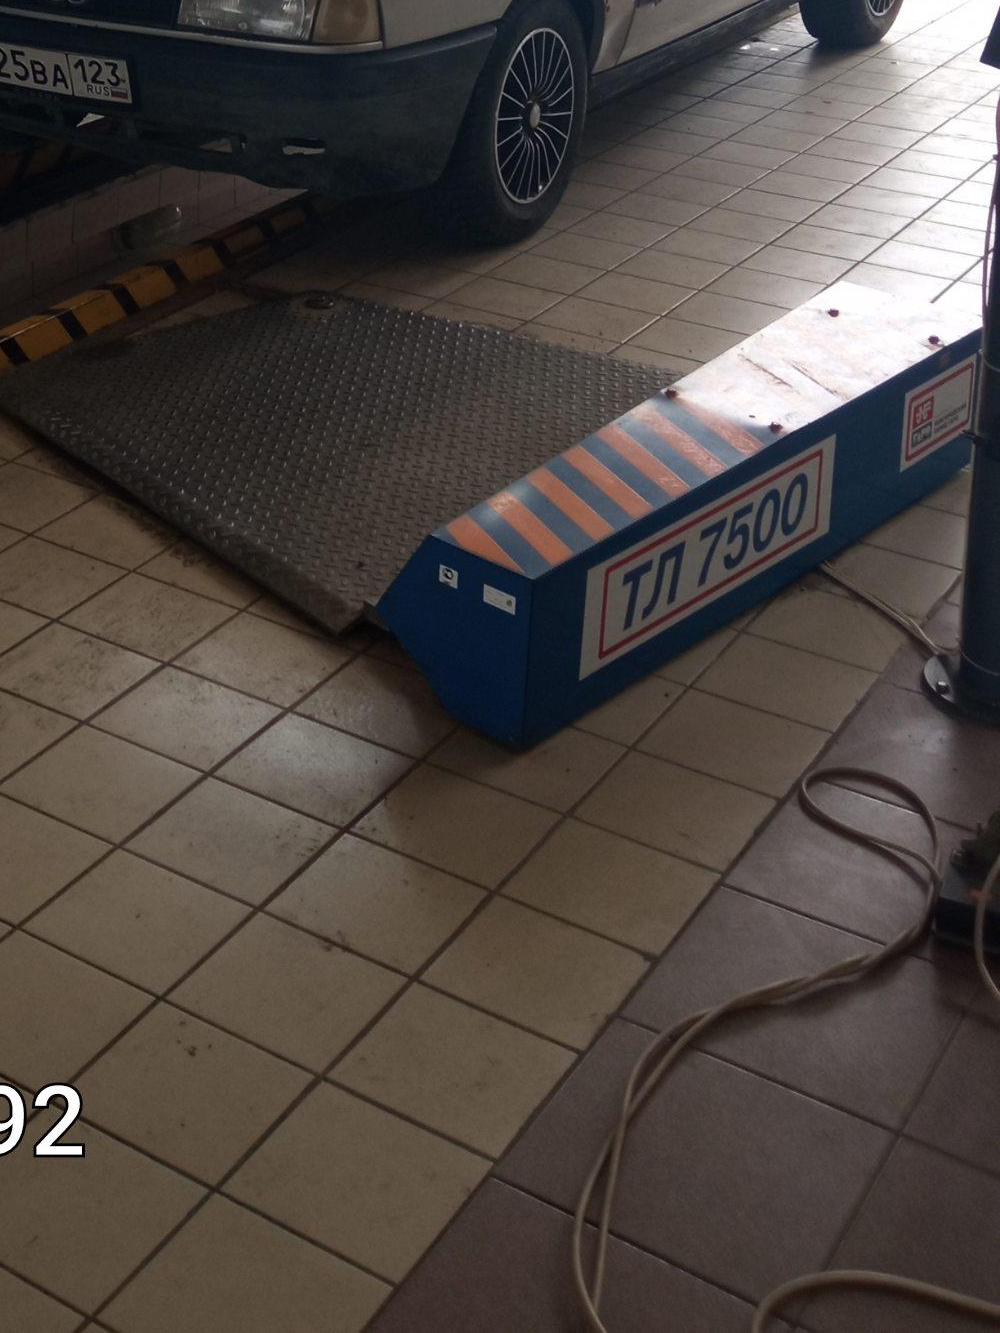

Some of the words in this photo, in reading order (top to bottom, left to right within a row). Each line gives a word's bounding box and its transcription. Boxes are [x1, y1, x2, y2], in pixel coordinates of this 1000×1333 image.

[74, 59, 120, 86] 123
[86, 85, 110, 96] RUS
[622, 541, 686, 631] ТЛ
[698, 473, 808, 587] 7500
